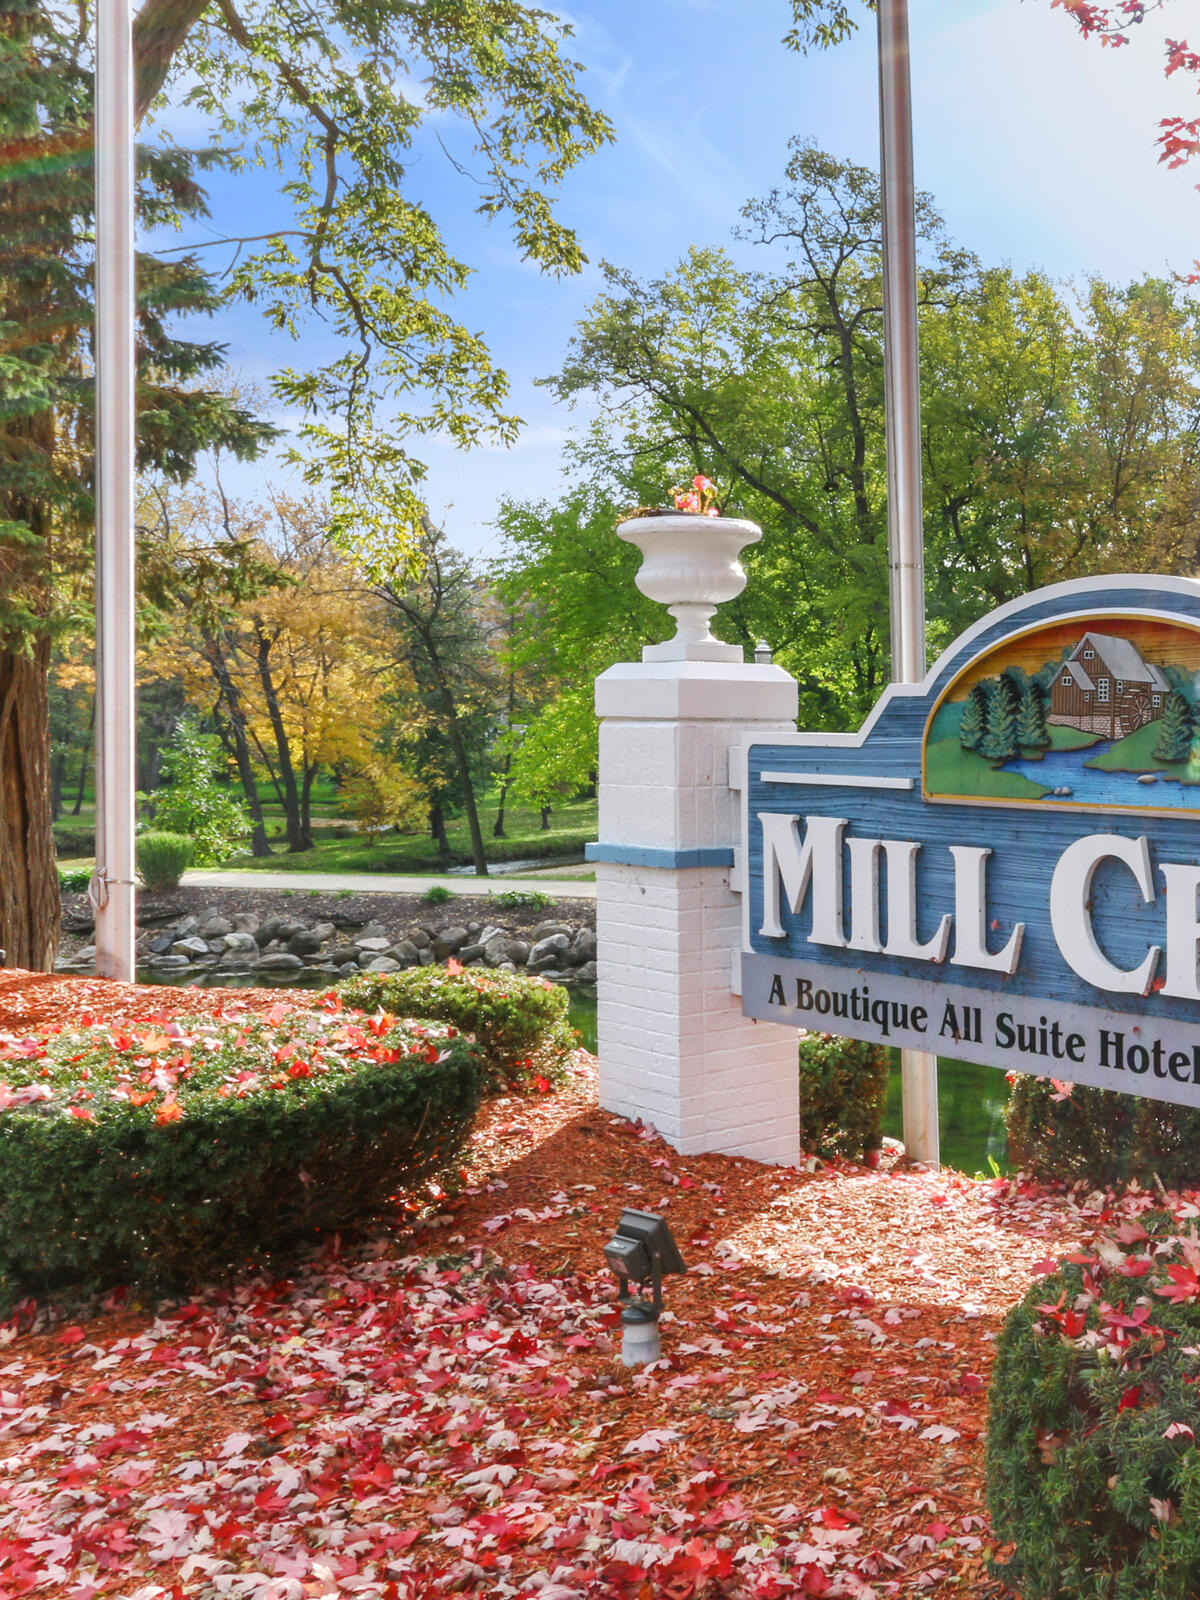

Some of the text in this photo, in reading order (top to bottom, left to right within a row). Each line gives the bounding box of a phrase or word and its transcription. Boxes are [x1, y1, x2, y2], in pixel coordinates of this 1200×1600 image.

[757, 812, 1025, 975] MILL
[768, 973, 787, 1007] A
[796, 978, 928, 1036] Boutique
[938, 1000, 983, 1044] All
[995, 1012, 1086, 1063] Suite
